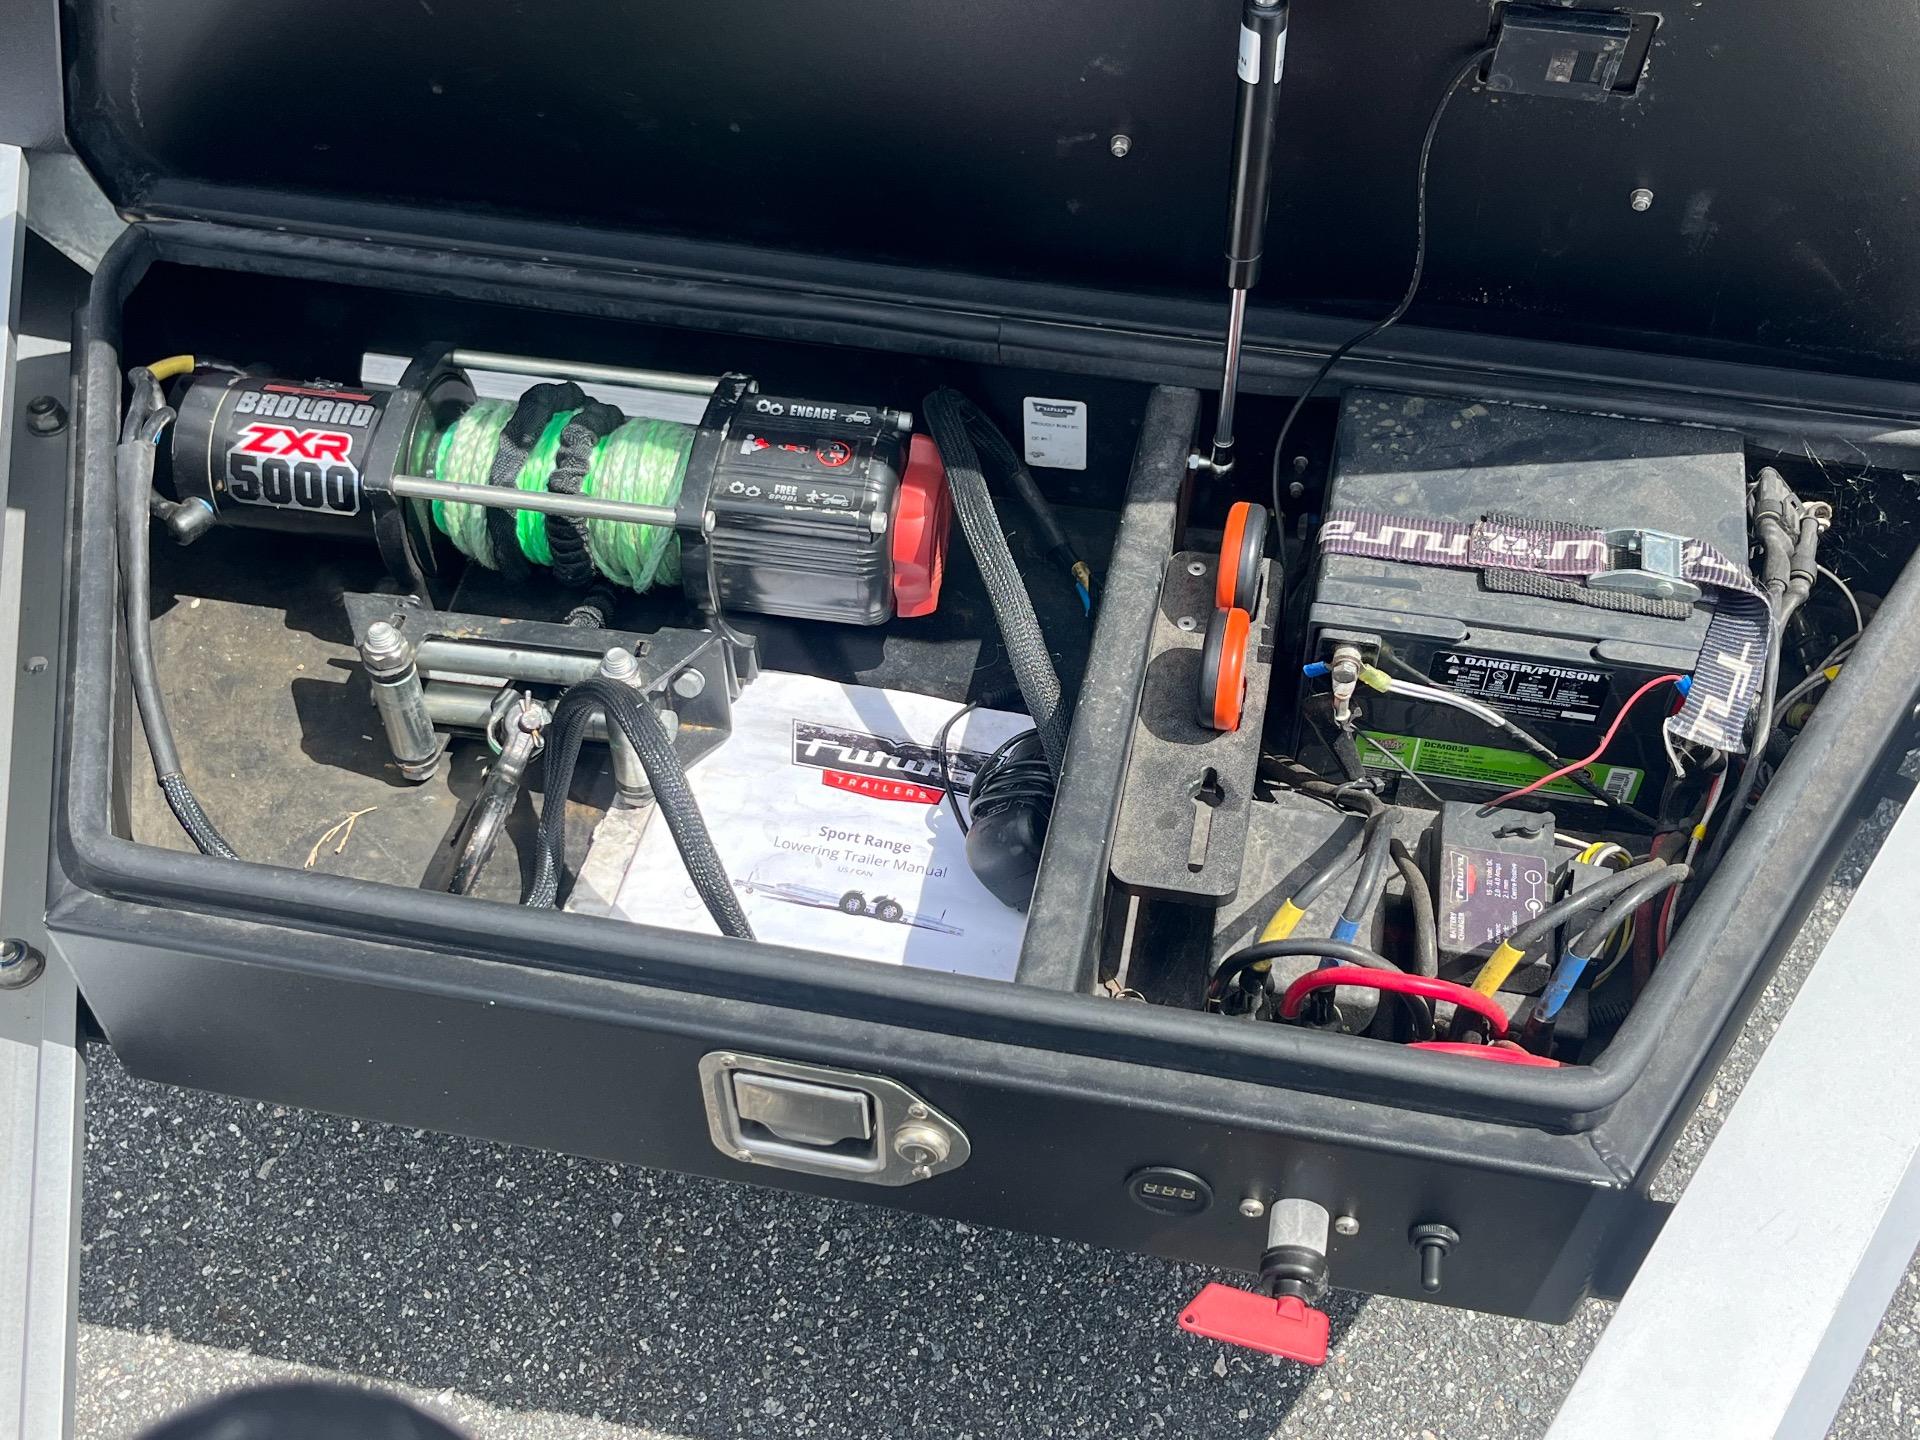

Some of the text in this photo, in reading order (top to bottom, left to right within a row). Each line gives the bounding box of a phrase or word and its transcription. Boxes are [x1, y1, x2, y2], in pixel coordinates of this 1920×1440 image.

[236, 391, 375, 427] BADLAND
[789, 404, 838, 421] ENGAGE
[239, 424, 351, 464] ZXR
[230, 453, 356, 512] 5000
[774, 484, 798, 496] FREE
[768, 494, 798, 503] SPOOL
[1464, 656, 1601, 683] DANGER/POISON
[1423, 740, 1470, 754] DCM0035
[837, 775, 928, 799] TRAILERS
[818, 825, 912, 854] Sport Range
[773, 836, 948, 879] Lowering Trailer Manual
[1456, 855, 1464, 898] Futura
[1457, 912, 1465, 941] CHARGER
